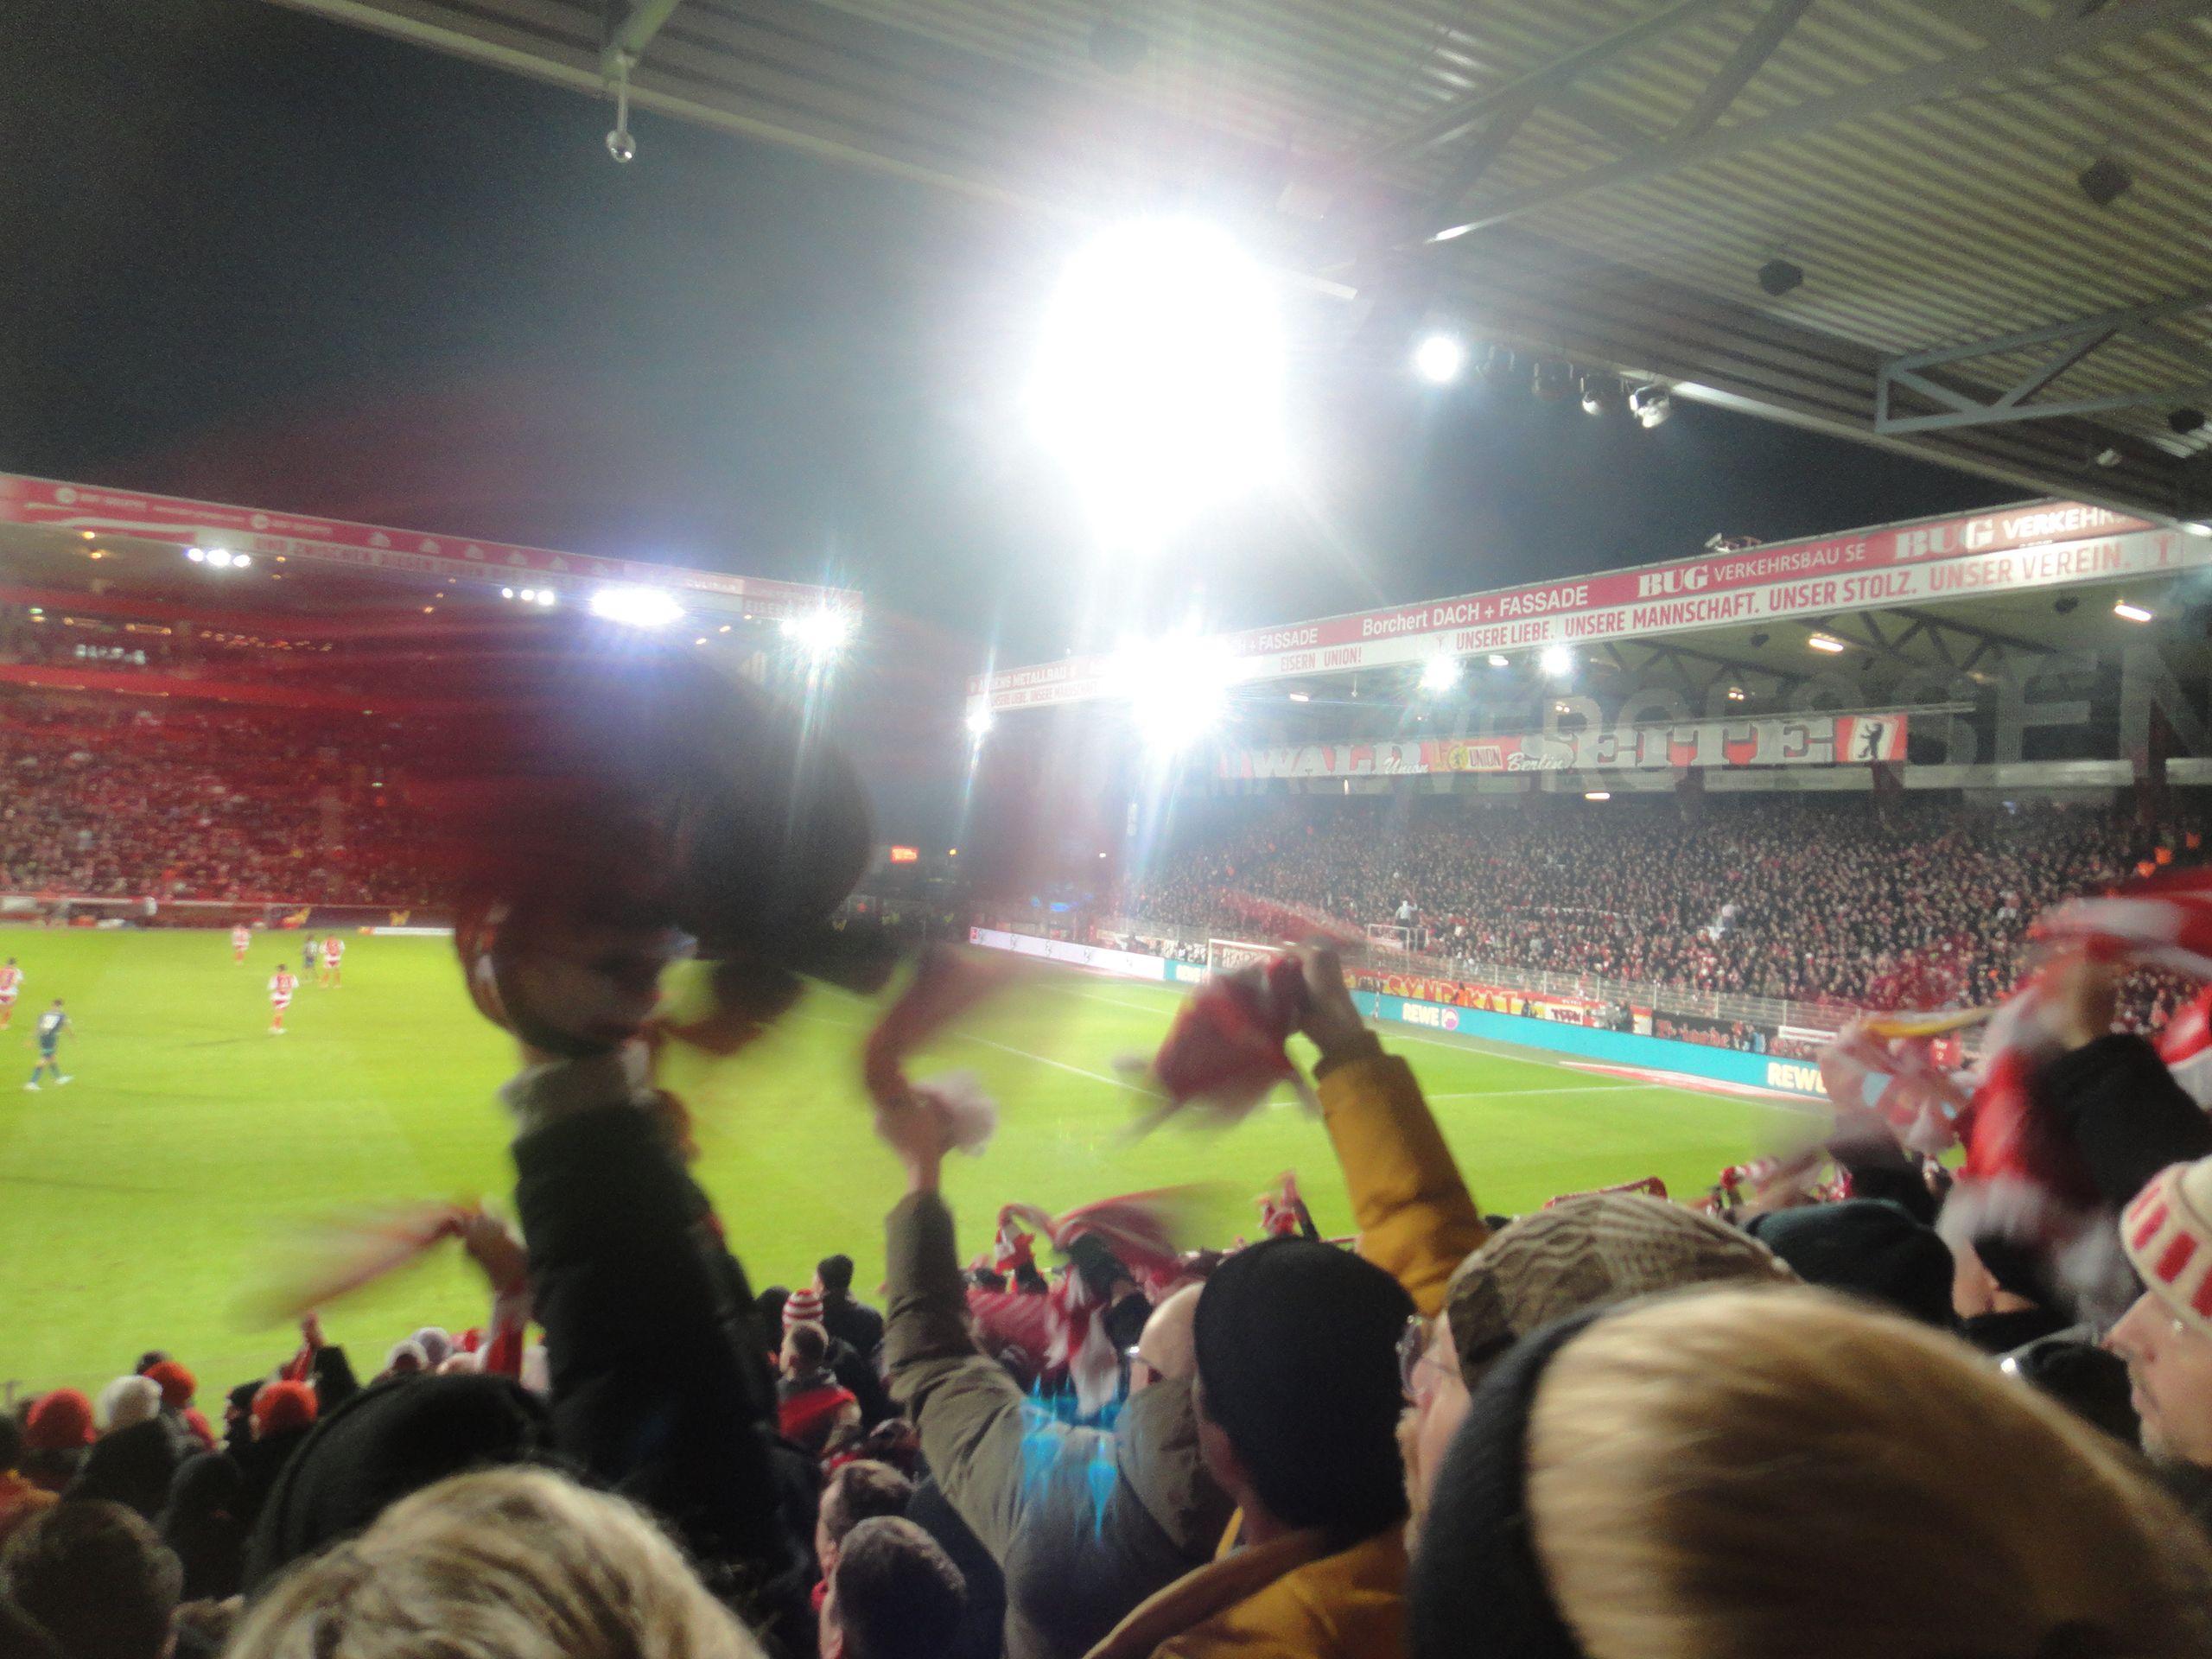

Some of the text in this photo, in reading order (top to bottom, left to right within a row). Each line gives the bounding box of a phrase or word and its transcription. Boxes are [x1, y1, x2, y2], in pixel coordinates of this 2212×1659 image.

[1895, 518, 1994, 559] BUG
[1637, 542, 1866, 598] BUG VERKEHRSBAU SE
[1362, 608, 1428, 637] Borchert
[1433, 601, 1480, 626] DACH
[1499, 584, 1589, 617] FASSADE
[1456, 541, 2132, 651] UNSERE LIEBE. UNSERE MANNSCHAFT. UNSER STOLZ. UNSER VEREIN.
[1258, 628, 1319, 651] FASSADE
[1280, 645, 1362, 672] EISERN UNION!
[1470, 747, 1502, 767] UNION
[1402, 1002, 1440, 1027] REWE
